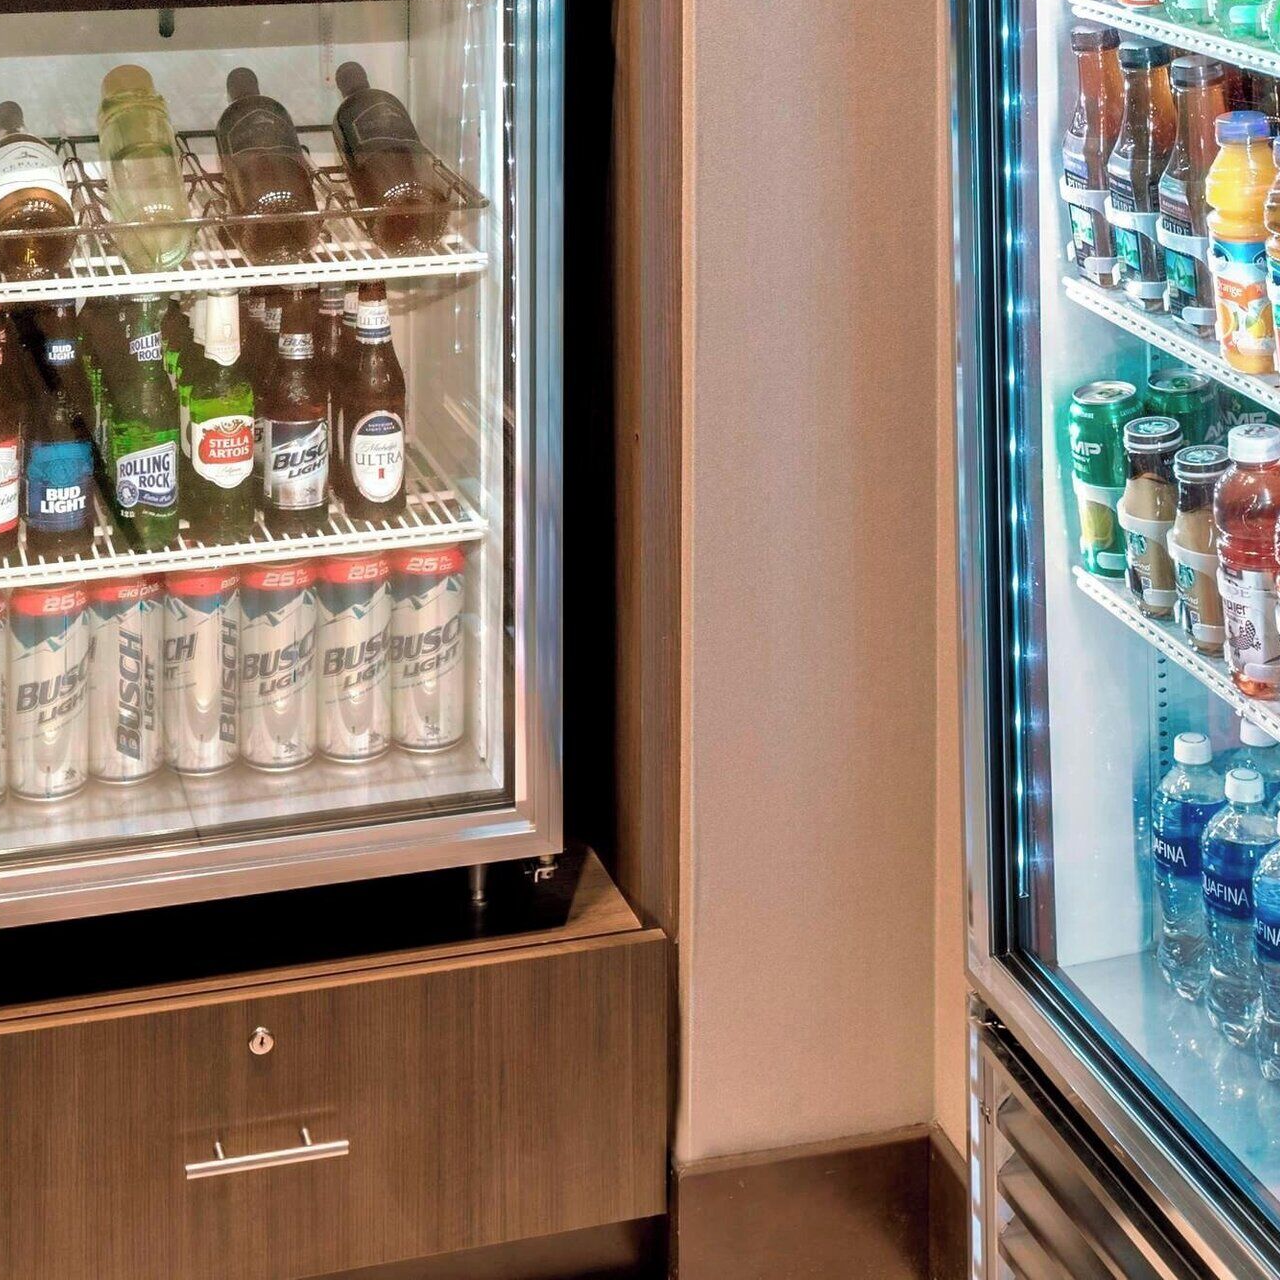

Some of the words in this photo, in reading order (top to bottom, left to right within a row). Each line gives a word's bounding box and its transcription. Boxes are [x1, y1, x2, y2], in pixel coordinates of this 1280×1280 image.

[48, 350, 76, 360] LIGHT
[52, 344, 72, 352] BUD
[209, 436, 250, 450] STELLA
[208, 446, 249, 459] ARTOIS
[355, 451, 403, 466] ULTRA
[120, 453, 170, 477] ROLLING
[138, 472, 170, 489] ROCK
[46, 486, 81, 501] BUD
[40, 497, 87, 514] LIGHT
[346, 562, 380, 581] 25
[406, 556, 438, 572] 25
[263, 569, 295, 587] 25
[43, 595, 77, 613] 25
[220, 620, 237, 744] BUSCH
[116, 630, 143, 761] BUSCH
[144, 656, 156, 732] LIGHT
